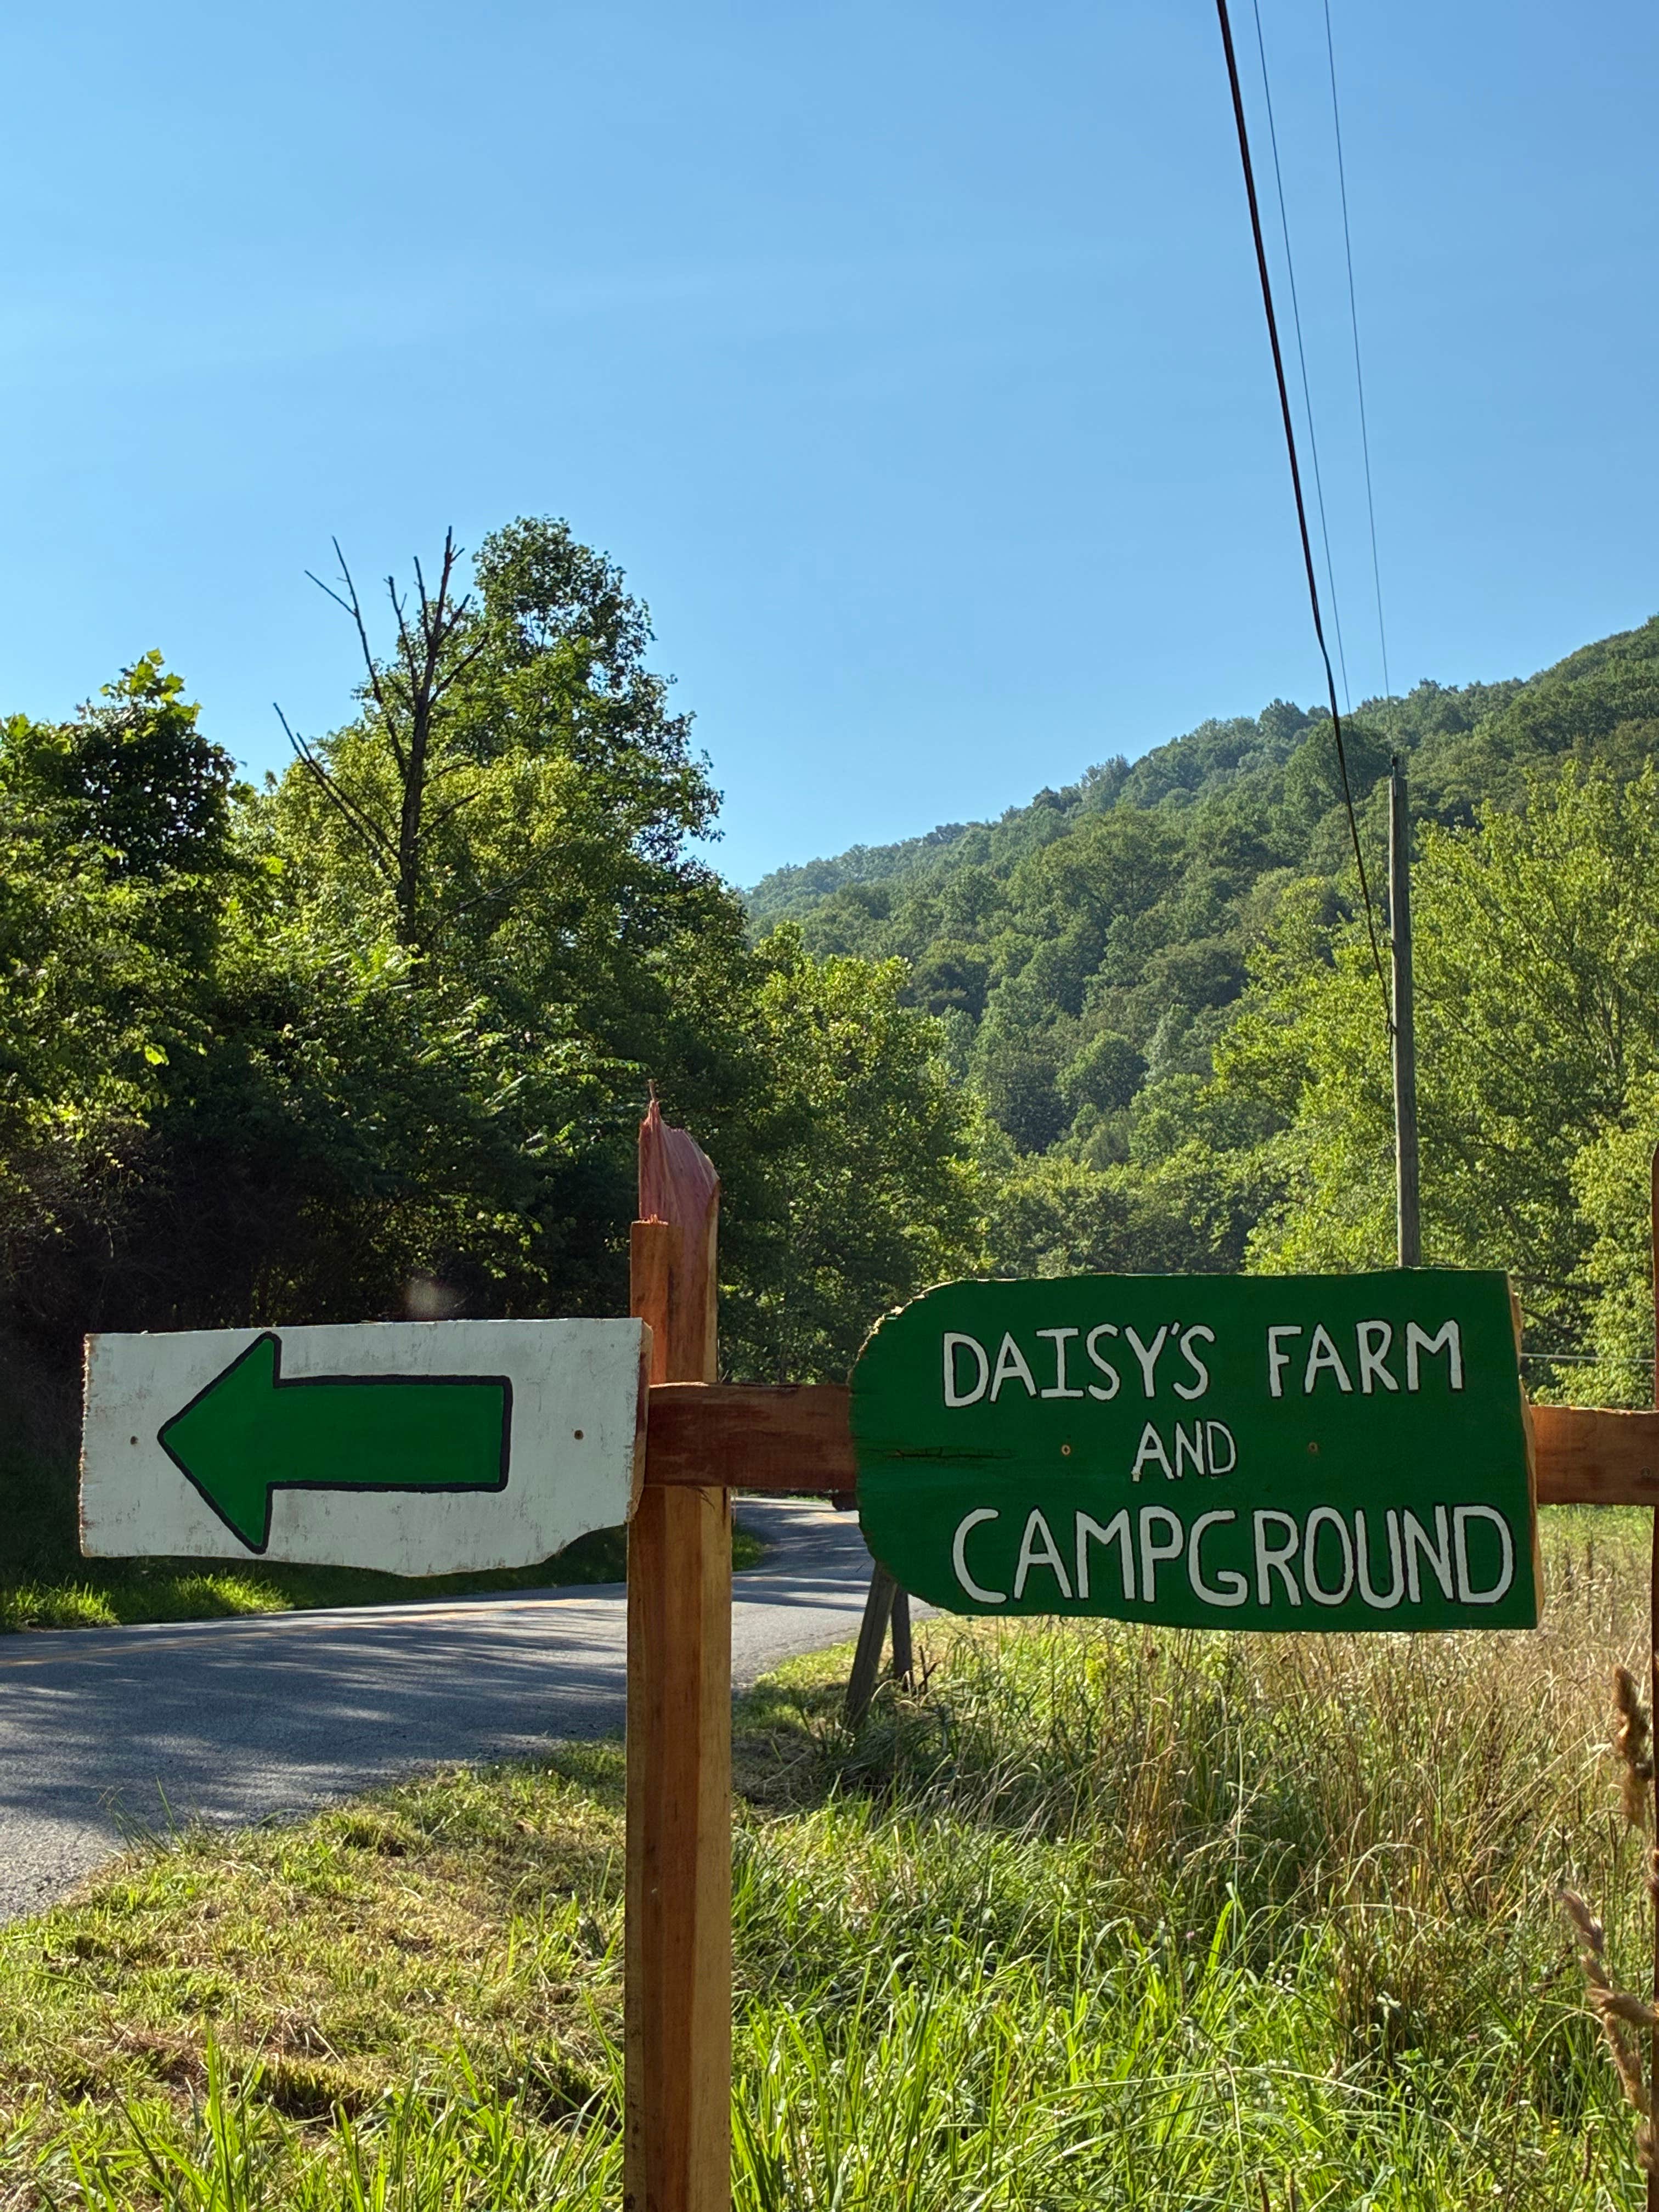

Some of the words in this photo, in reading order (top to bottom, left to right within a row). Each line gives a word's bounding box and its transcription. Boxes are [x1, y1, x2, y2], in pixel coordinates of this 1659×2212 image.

[943, 1322, 1215, 1407] DAISY'S
[1267, 1319, 1463, 1397] FARM
[1131, 1420, 1237, 1482] AND
[952, 1505, 1514, 1609] CAMPGROUND
